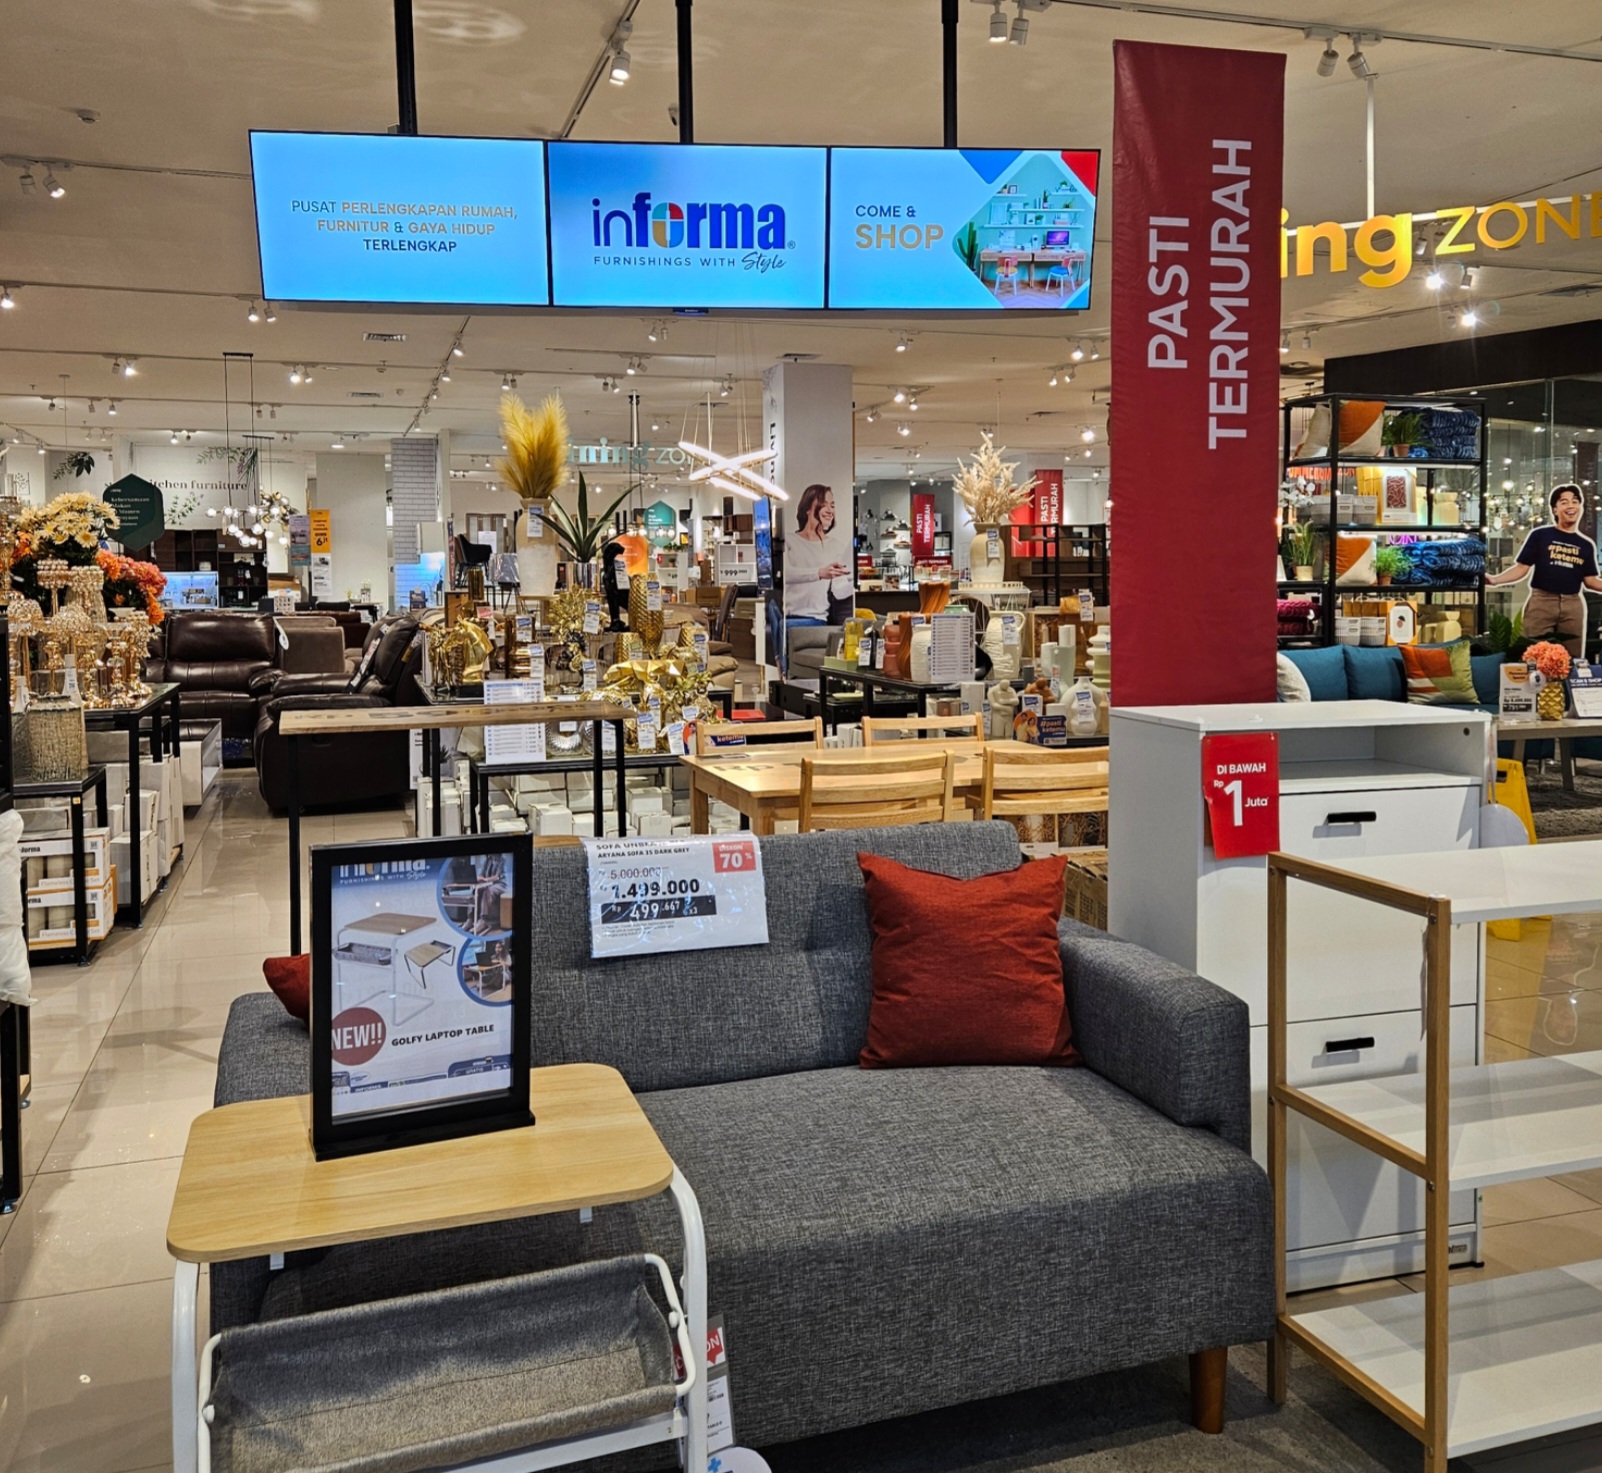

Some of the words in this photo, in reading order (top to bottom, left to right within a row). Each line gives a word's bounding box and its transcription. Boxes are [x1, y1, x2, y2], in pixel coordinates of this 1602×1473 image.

[291, 200, 337, 214] PUSAT
[341, 202, 457, 217] PERLENGKAPAN
[461, 206, 518, 220] RUMAH,
[592, 192, 786, 250] informa
[855, 205, 901, 218] COME
[906, 205, 917, 218] &
[317, 219, 389, 234] FURNITUR
[393, 222, 403, 234] &
[408, 222, 448, 235] GAYA
[451, 223, 495, 236] HIDUP
[855, 223, 945, 250] SHOP
[362, 238, 458, 254] TERLENGKAP
[593, 255, 692, 267] FURNISHINGS
[700, 257, 735, 267] WITH
[741, 251, 787, 274] Style
[1147, 215, 1190, 369] PASTI
[1208, 138, 1253, 450] TERMURAH
[150, 479, 188, 490] itchen
[191, 480, 248, 491] furniture
[923, 504, 931, 543] TERMURAH
[1216, 765, 1227, 775] DI
[1229, 763, 1267, 774] BAWAH
[1213, 780, 1224, 789] Rp
[1223, 780, 1243, 827] 1
[1244, 797, 1268, 808] Juta
[598, 850, 626, 858] ARYANA
[718, 844, 744, 852] DISKON
[720, 852, 743, 869] 70
[744, 851, 753, 860] %
[611, 878, 700, 900] 1.499.000
[331, 1022, 383, 1051] NEW!!
[391, 1034, 423, 1047] GOLFY
[424, 1028, 463, 1043] LAPTOP
[465, 1024, 495, 1037] TABLE
